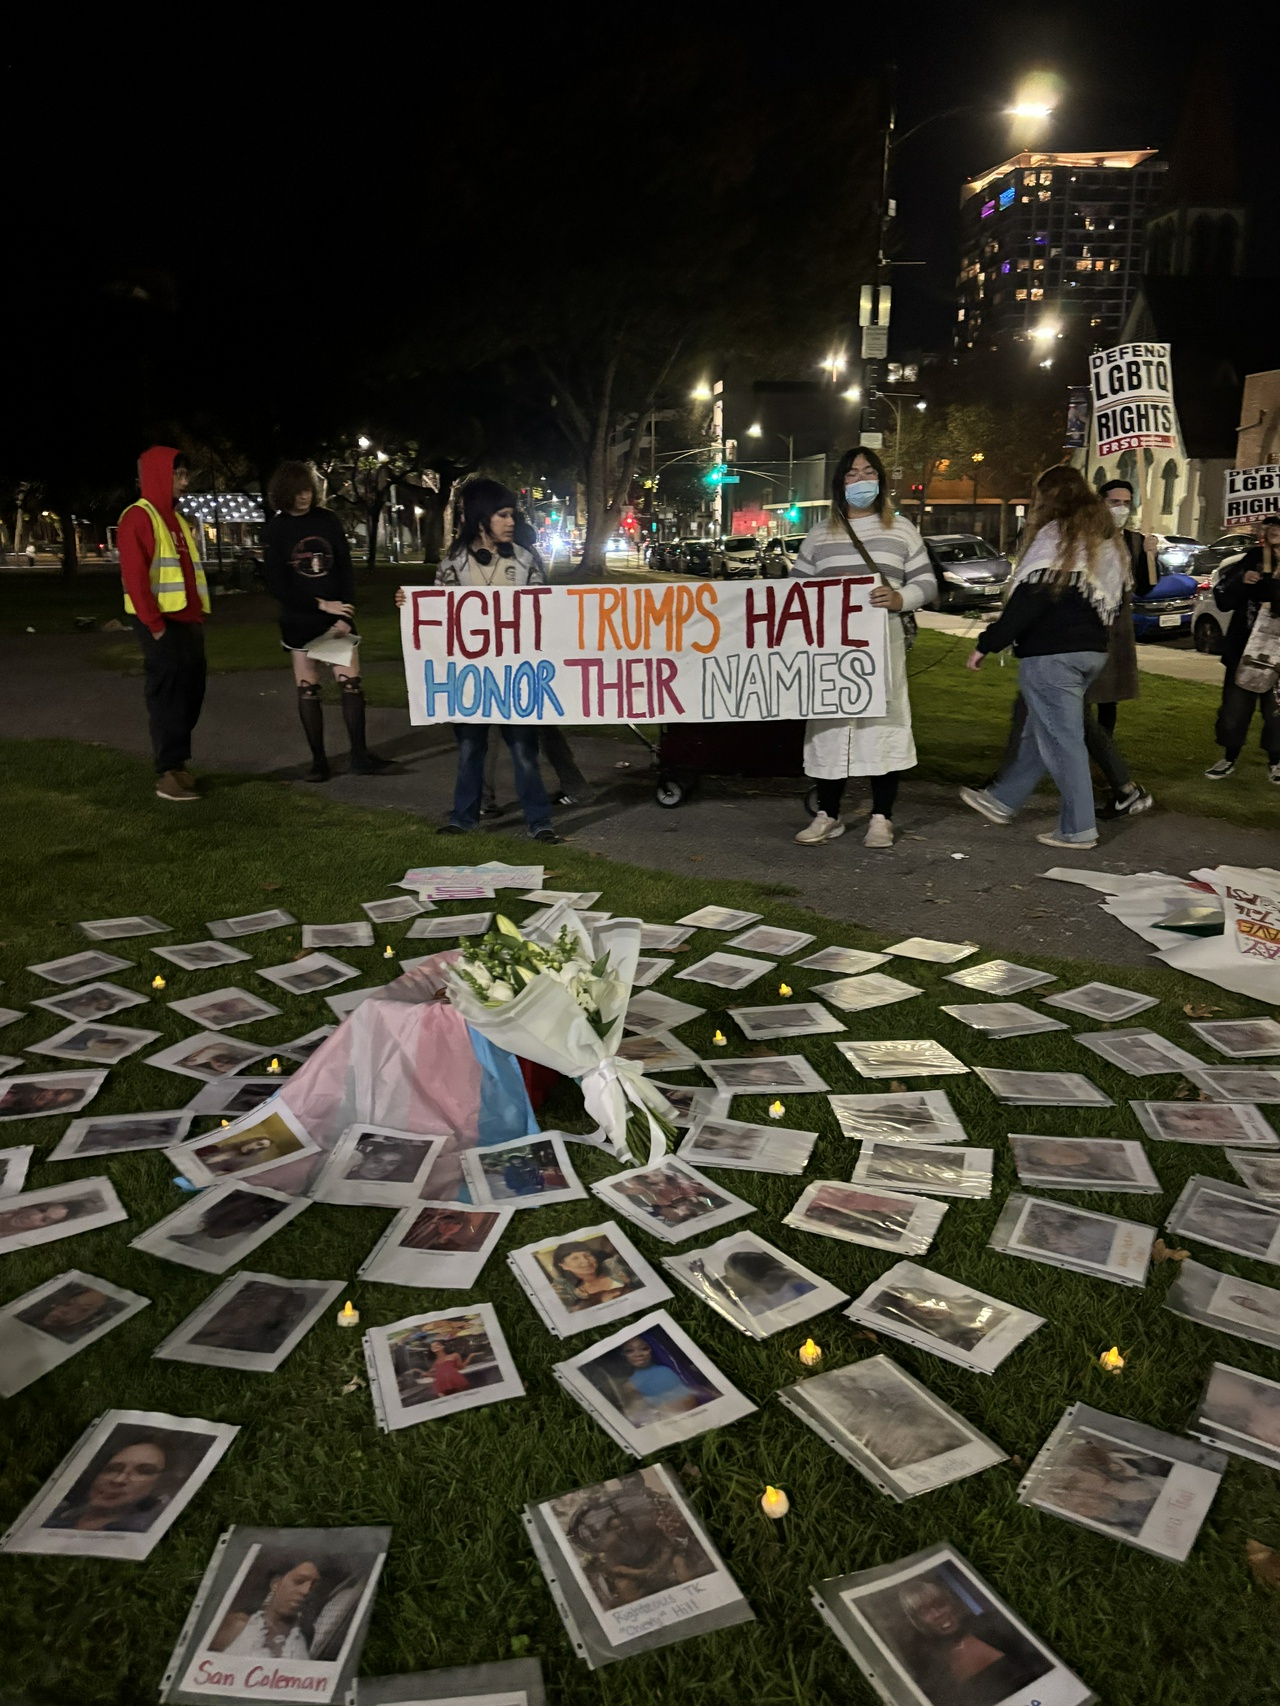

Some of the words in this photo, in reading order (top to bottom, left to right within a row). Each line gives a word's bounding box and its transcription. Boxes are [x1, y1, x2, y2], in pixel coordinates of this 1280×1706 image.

[1092, 344, 1167, 369] DEFEND
[1093, 360, 1169, 401] LGBTQ
[1097, 404, 1171, 442] RIGHTS
[1229, 466, 1280, 478] DEFE
[1228, 497, 1279, 517] RIGH
[412, 587, 553, 659] FIGHT
[567, 583, 721, 654] TRUMPS
[746, 577, 875, 649] HATE
[424, 659, 566, 720] HONOR
[563, 658, 685, 719] THEIR
[702, 649, 876, 720] NAMES
[1241, 921, 1280, 942] AVE
[671, 1599, 700, 1618] Hill
[193, 1660, 235, 1686] San
[244, 1665, 329, 1692] Coleman
